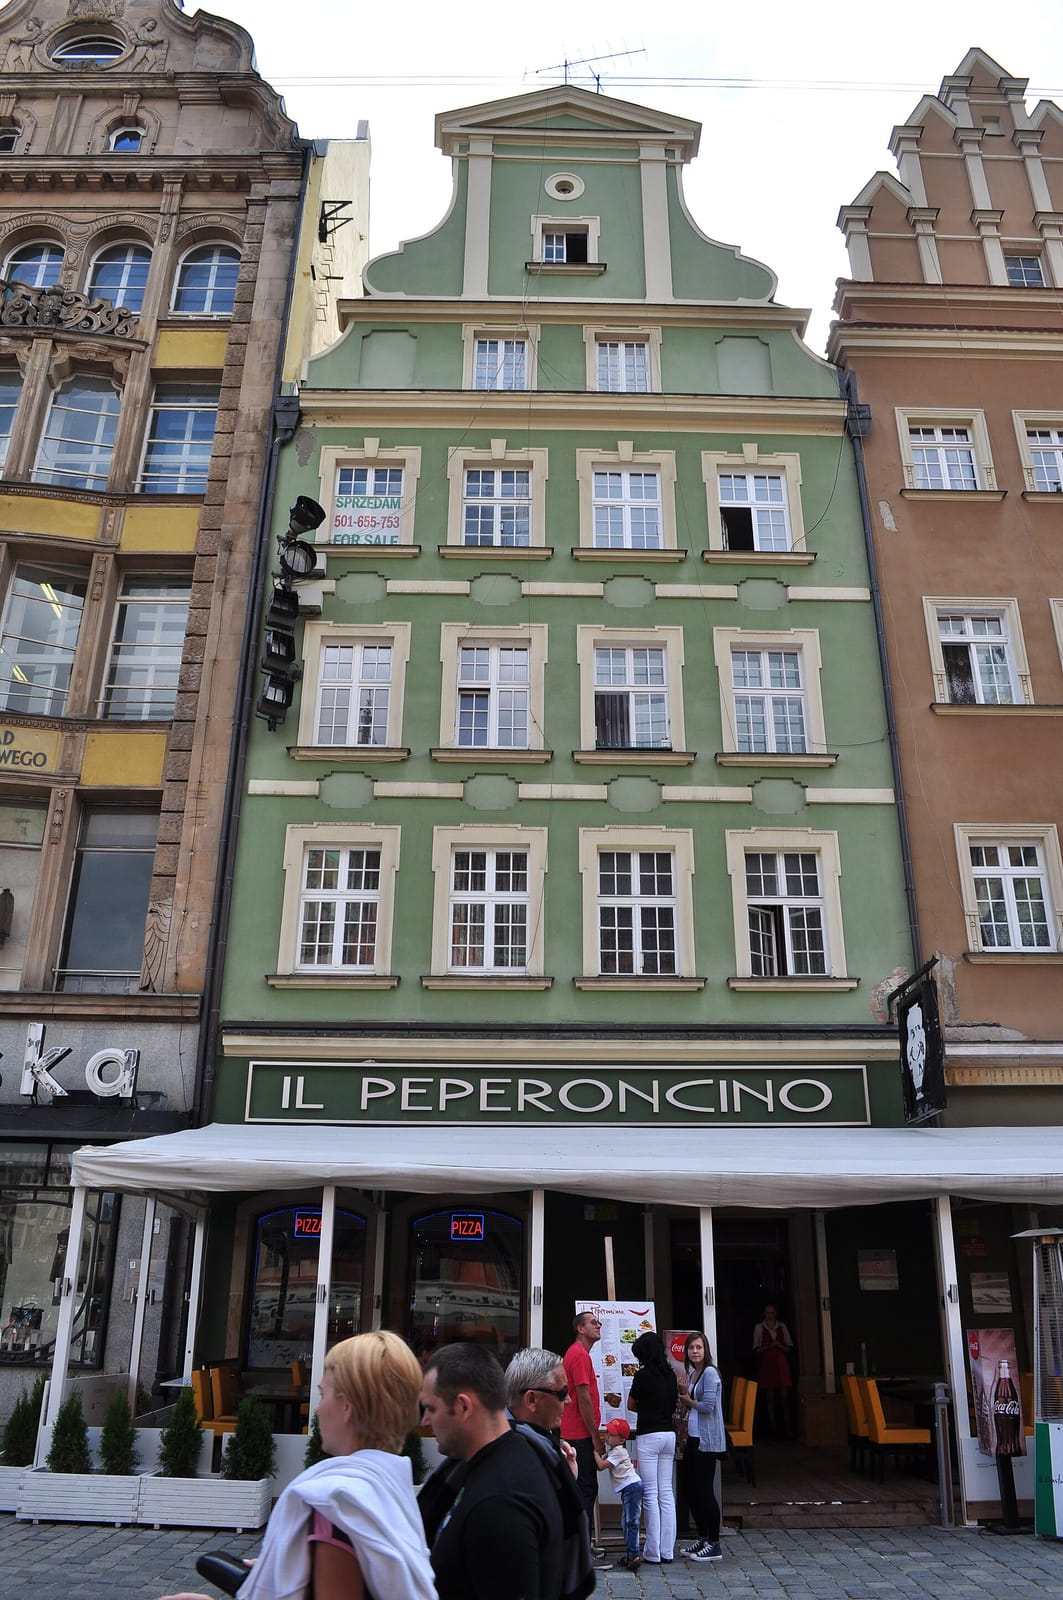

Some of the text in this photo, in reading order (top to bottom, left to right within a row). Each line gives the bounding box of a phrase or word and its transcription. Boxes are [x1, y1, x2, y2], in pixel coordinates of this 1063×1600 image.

[335, 496, 401, 509] SPRZEDAM
[334, 515, 400, 528] 501-655-753
[333, 533, 399, 545] FOR SALE
[0, 1022, 140, 1098] ka
[281, 1075, 833, 1113] IL PEPERONCINO
[451, 1221, 483, 1235] PIZZA
